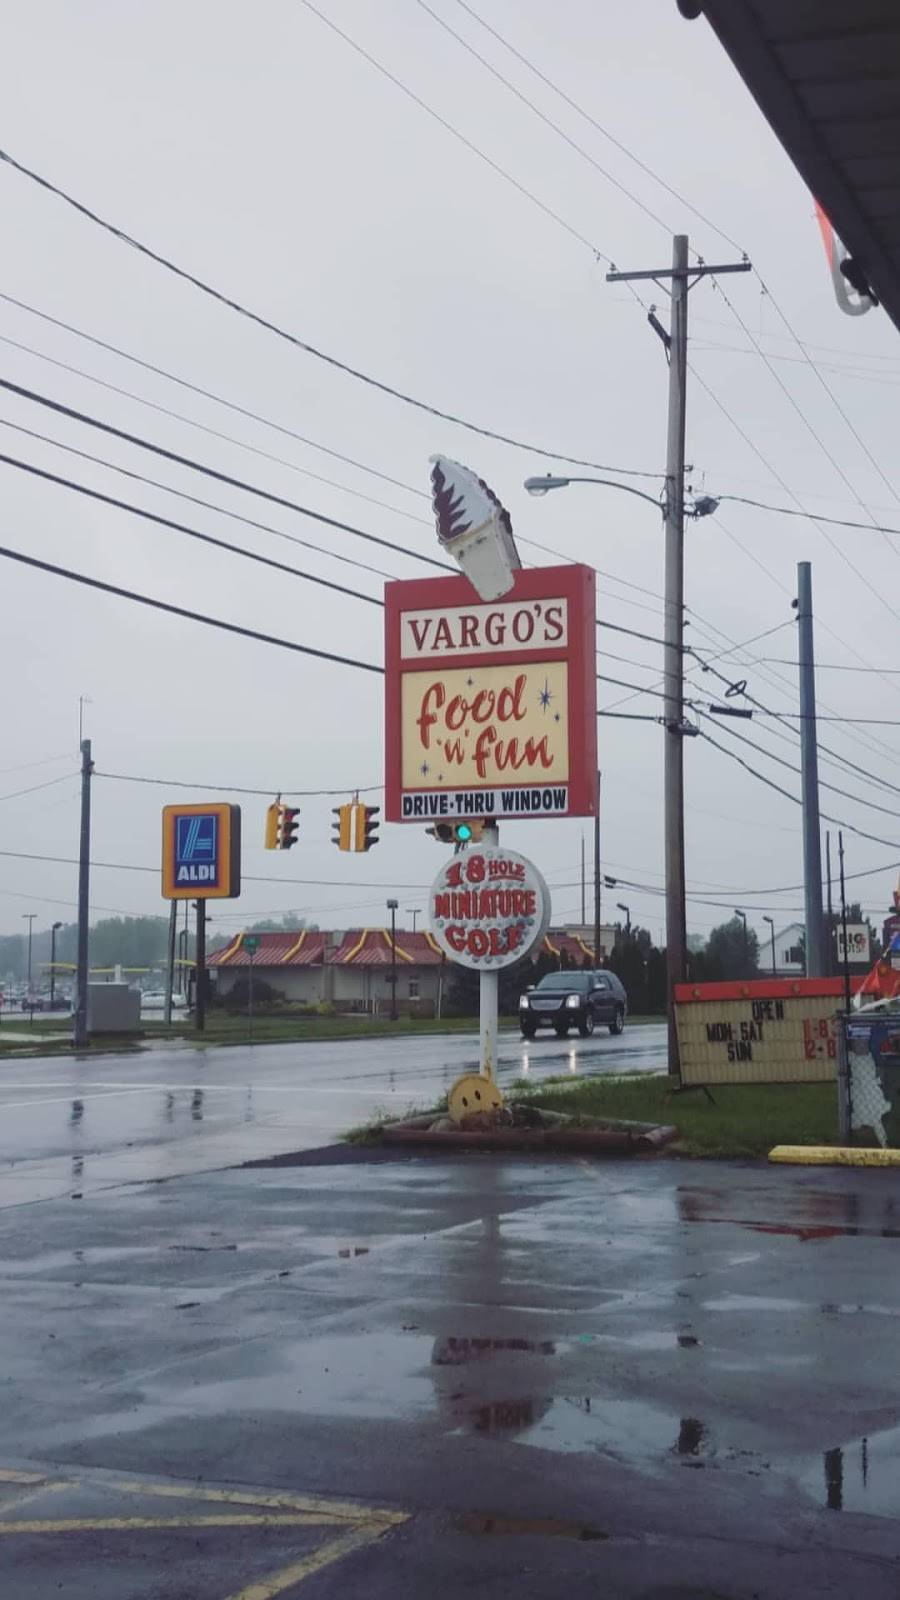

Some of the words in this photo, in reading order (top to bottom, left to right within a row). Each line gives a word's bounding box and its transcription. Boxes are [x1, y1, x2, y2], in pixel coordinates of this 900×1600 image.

[408, 604, 564, 651] VARGO'S
[416, 674, 527, 750] food
[471, 725, 554, 778] fun
[501, 788, 567, 811] WINDOW
[177, 864, 216, 881] ALDI
[446, 854, 486, 887] 18
[488, 859, 526, 878] HOLE
[435, 889, 536, 919] MINIATURE
[445, 922, 526, 957] GOLF
[752, 1000, 784, 1021] OPEN
[727, 1041, 752, 1061] SUN
